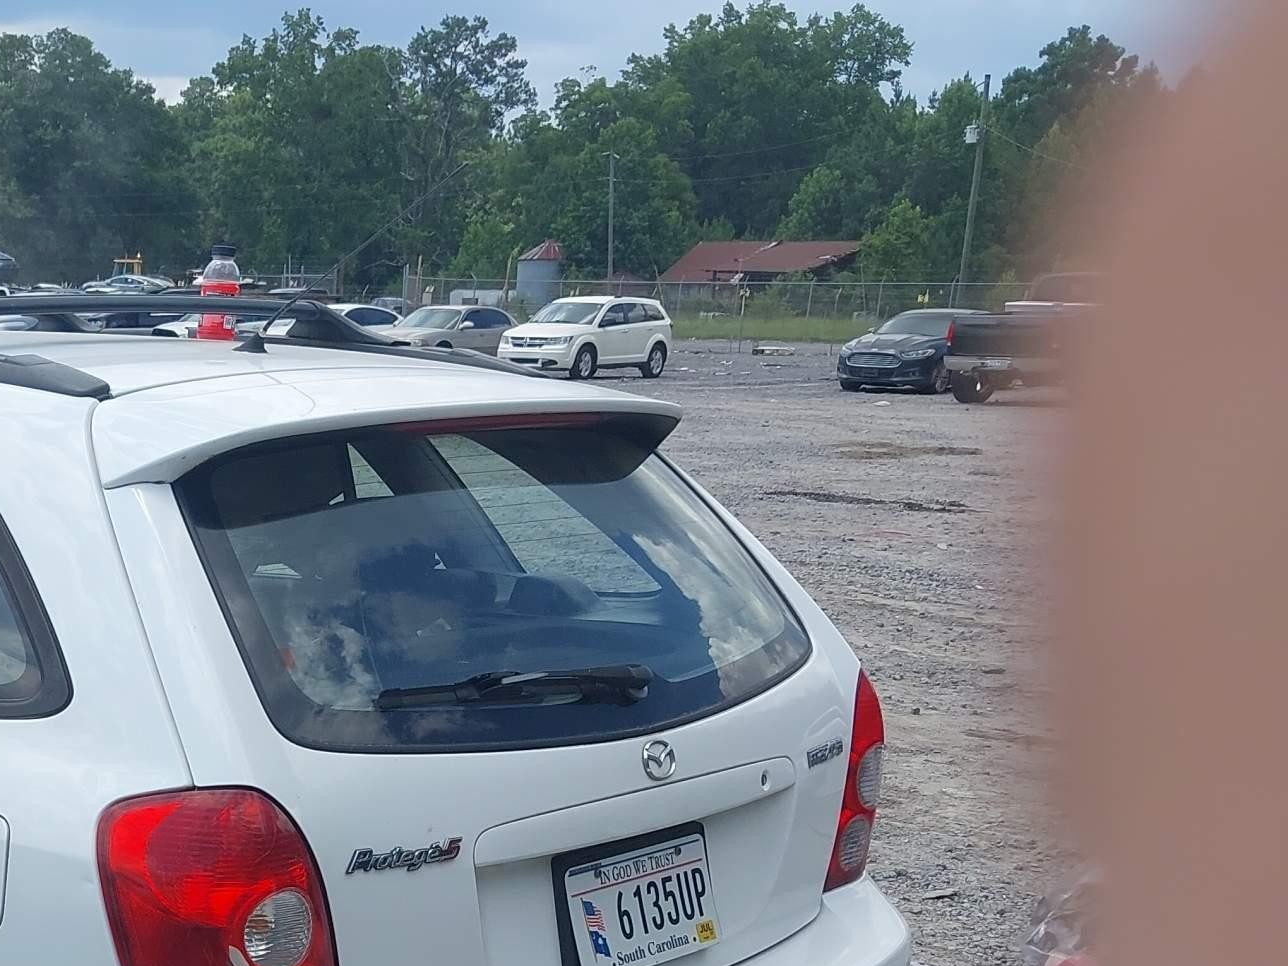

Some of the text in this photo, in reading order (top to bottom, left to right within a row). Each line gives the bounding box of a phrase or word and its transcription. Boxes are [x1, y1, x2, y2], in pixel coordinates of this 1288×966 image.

[599, 870, 611, 885] IN
[612, 864, 632, 881] GOD
[634, 859, 648, 877] WE
[648, 852, 675, 871] TRUST
[617, 867, 706, 940] 6135UP
[617, 935, 690, 966] South Carolina
